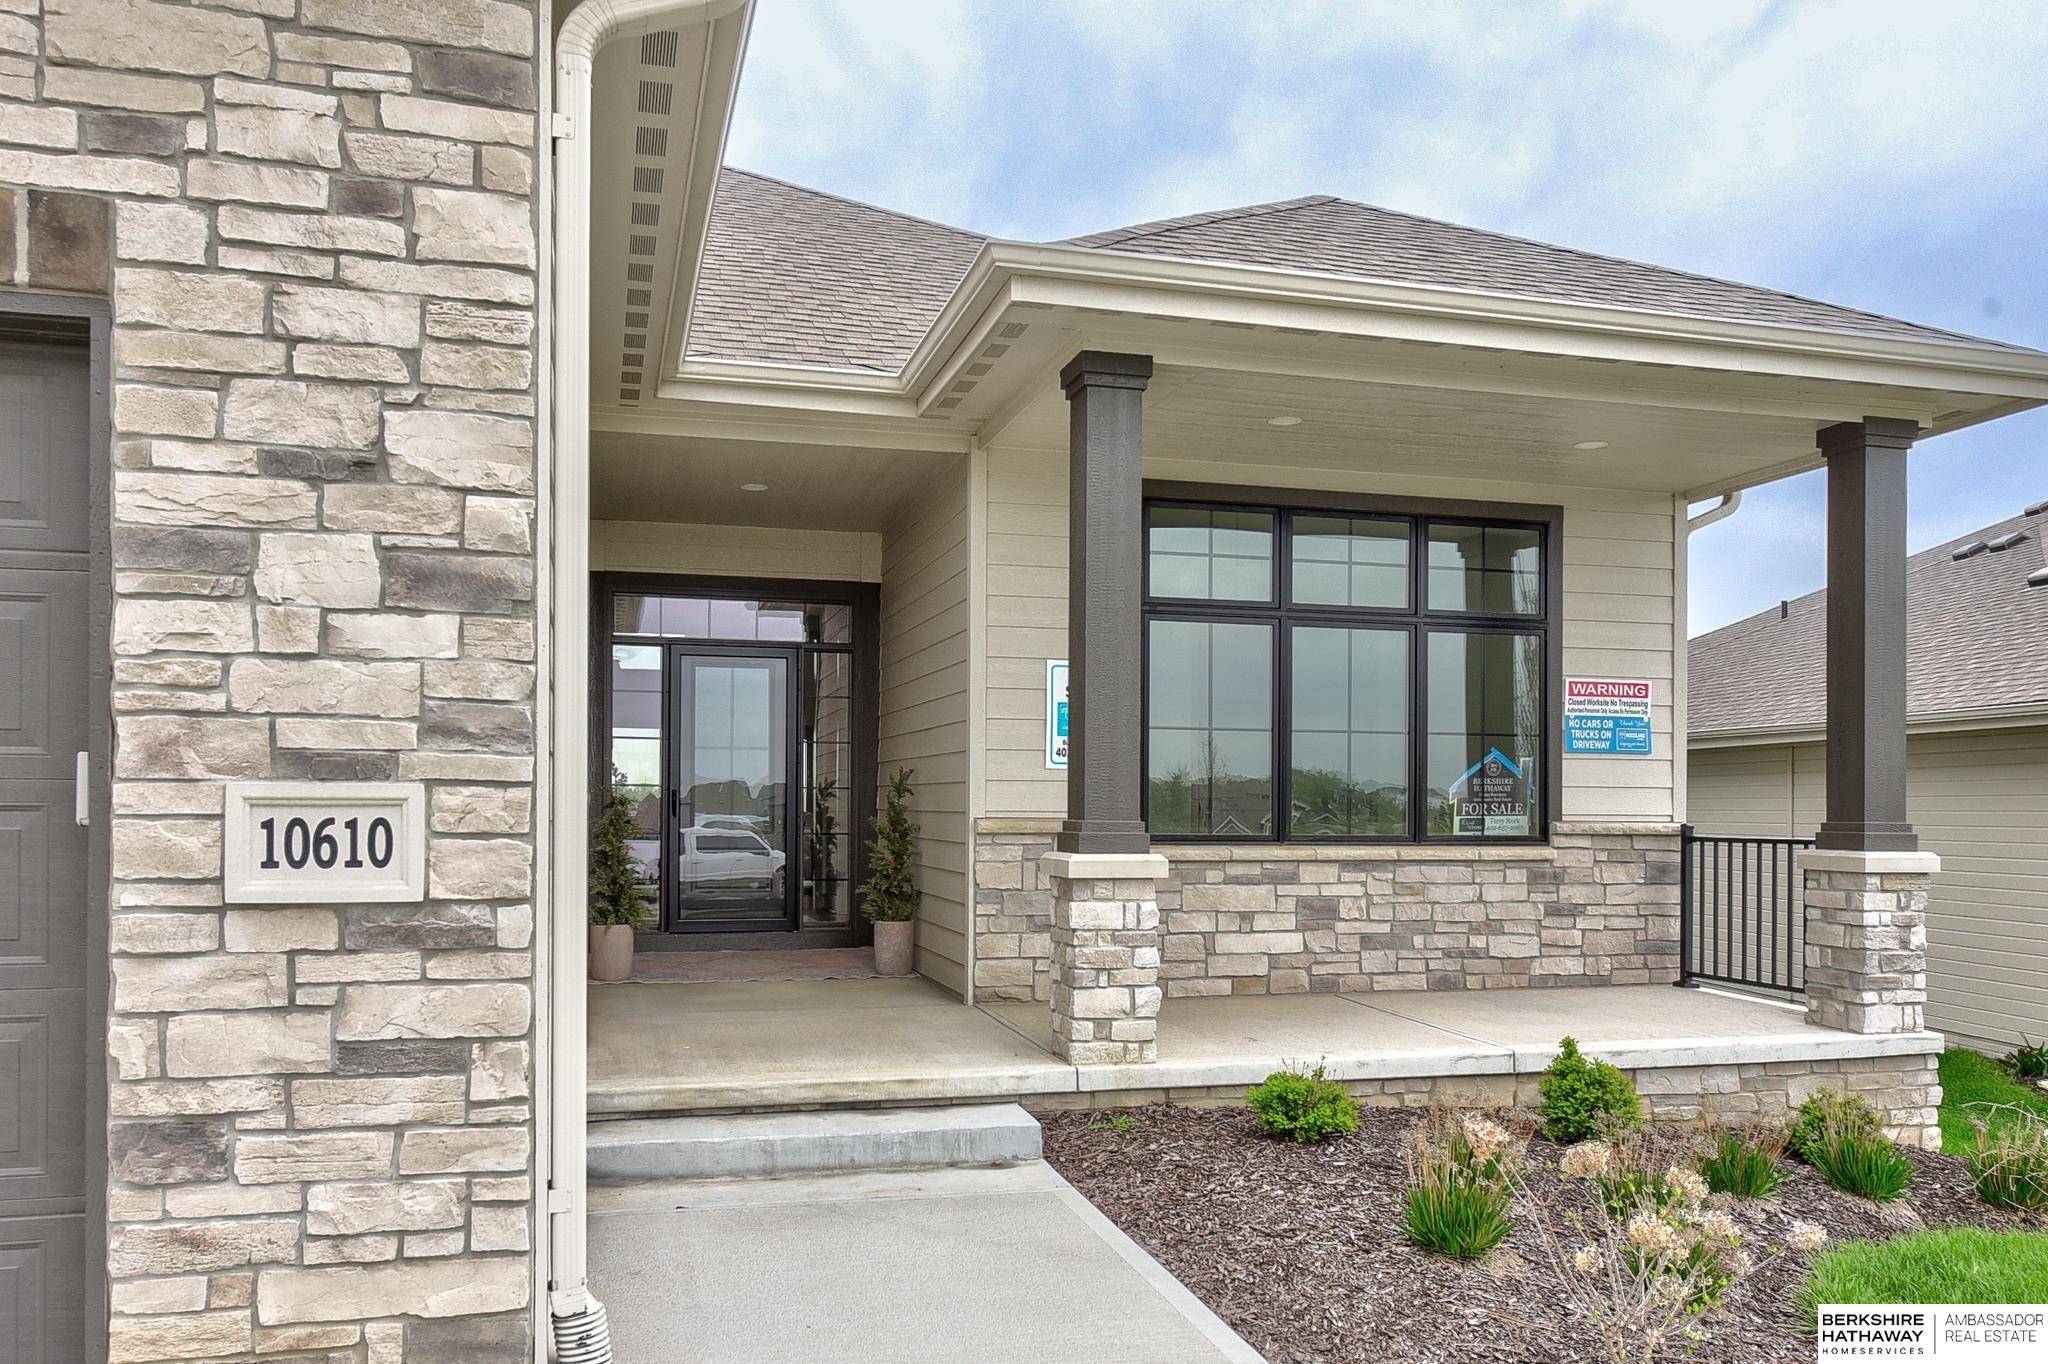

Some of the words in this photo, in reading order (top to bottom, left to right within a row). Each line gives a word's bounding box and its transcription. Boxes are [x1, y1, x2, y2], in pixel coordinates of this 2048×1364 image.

[1571, 683, 1646, 696] WARNING
[1567, 698, 1586, 706] Closed
[1610, 699, 1617, 707] No
[1619, 699, 1648, 709] Trespassing
[1568, 720, 1580, 728] NO
[1581, 720, 1601, 728] CARS
[1602, 720, 1614, 729] OR
[1571, 730, 1599, 738] TRUCKS
[1600, 731, 1612, 739] ON
[1572, 741, 1610, 749] DRIVEWAY
[1462, 803, 1488, 815] FOR
[1490, 803, 1523, 815] SALE
[260, 817, 393, 869] 10610
